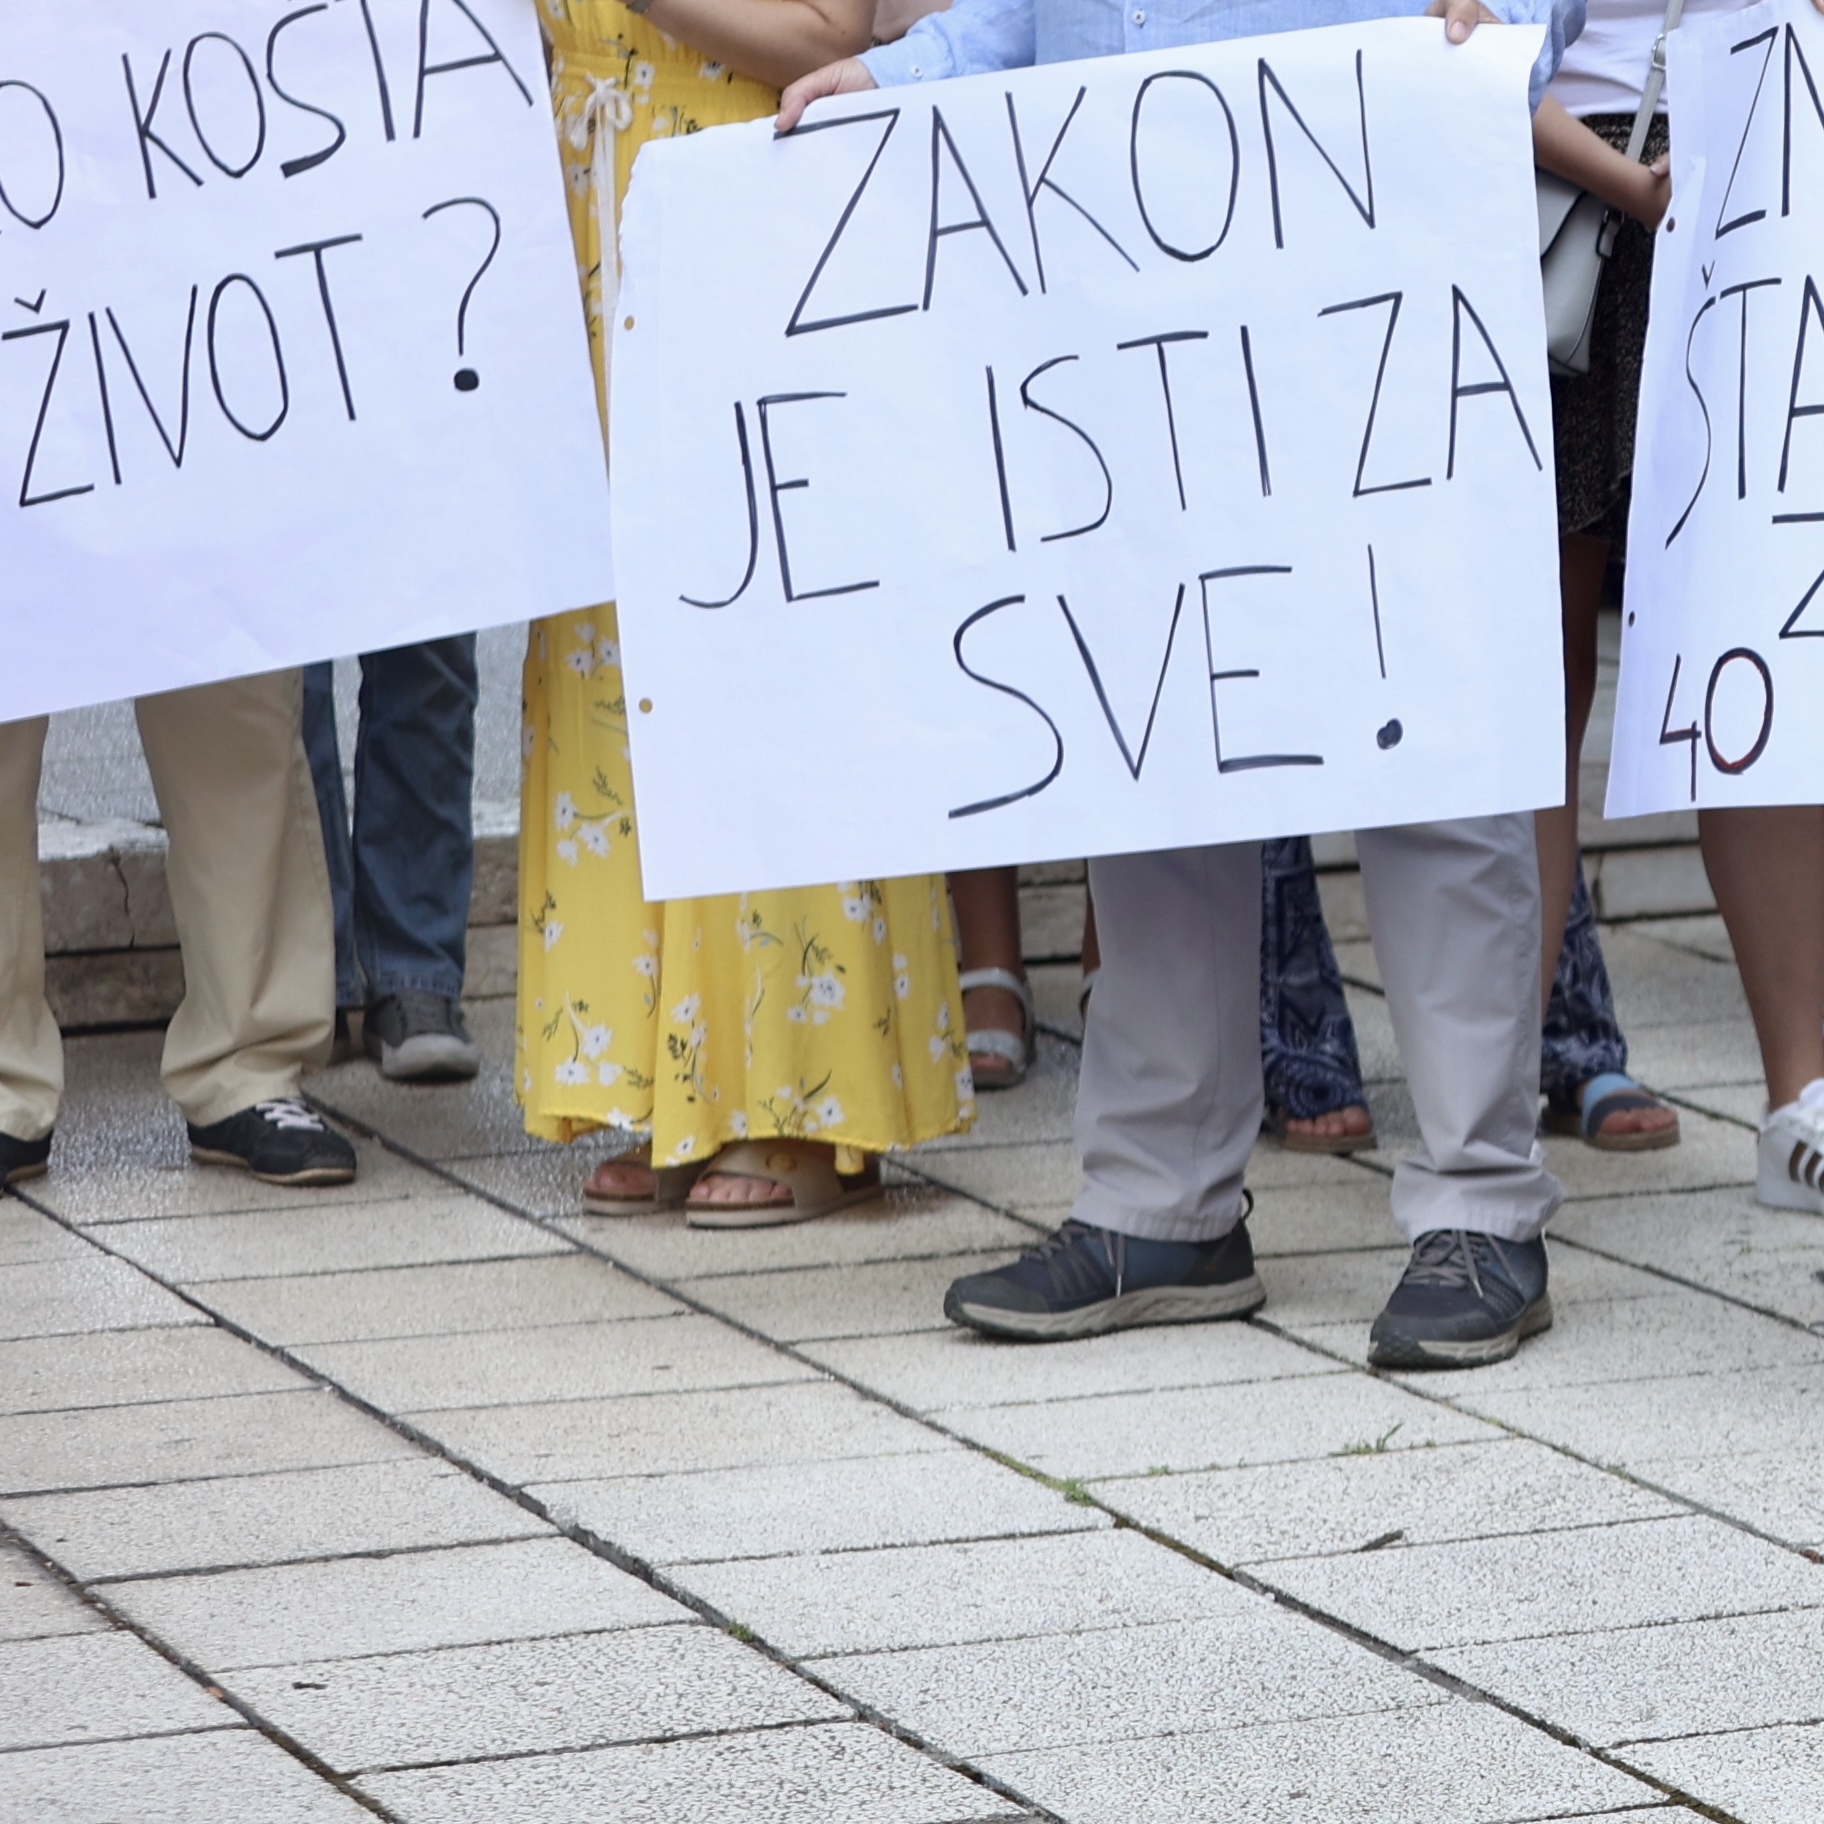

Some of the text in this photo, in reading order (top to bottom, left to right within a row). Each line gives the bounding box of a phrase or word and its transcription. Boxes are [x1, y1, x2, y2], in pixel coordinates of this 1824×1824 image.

[773, 49, 1376, 337] ZAKON
[679, 284, 1543, 609] JE ISTI ZA
[1658, 645, 1774, 803] 40
